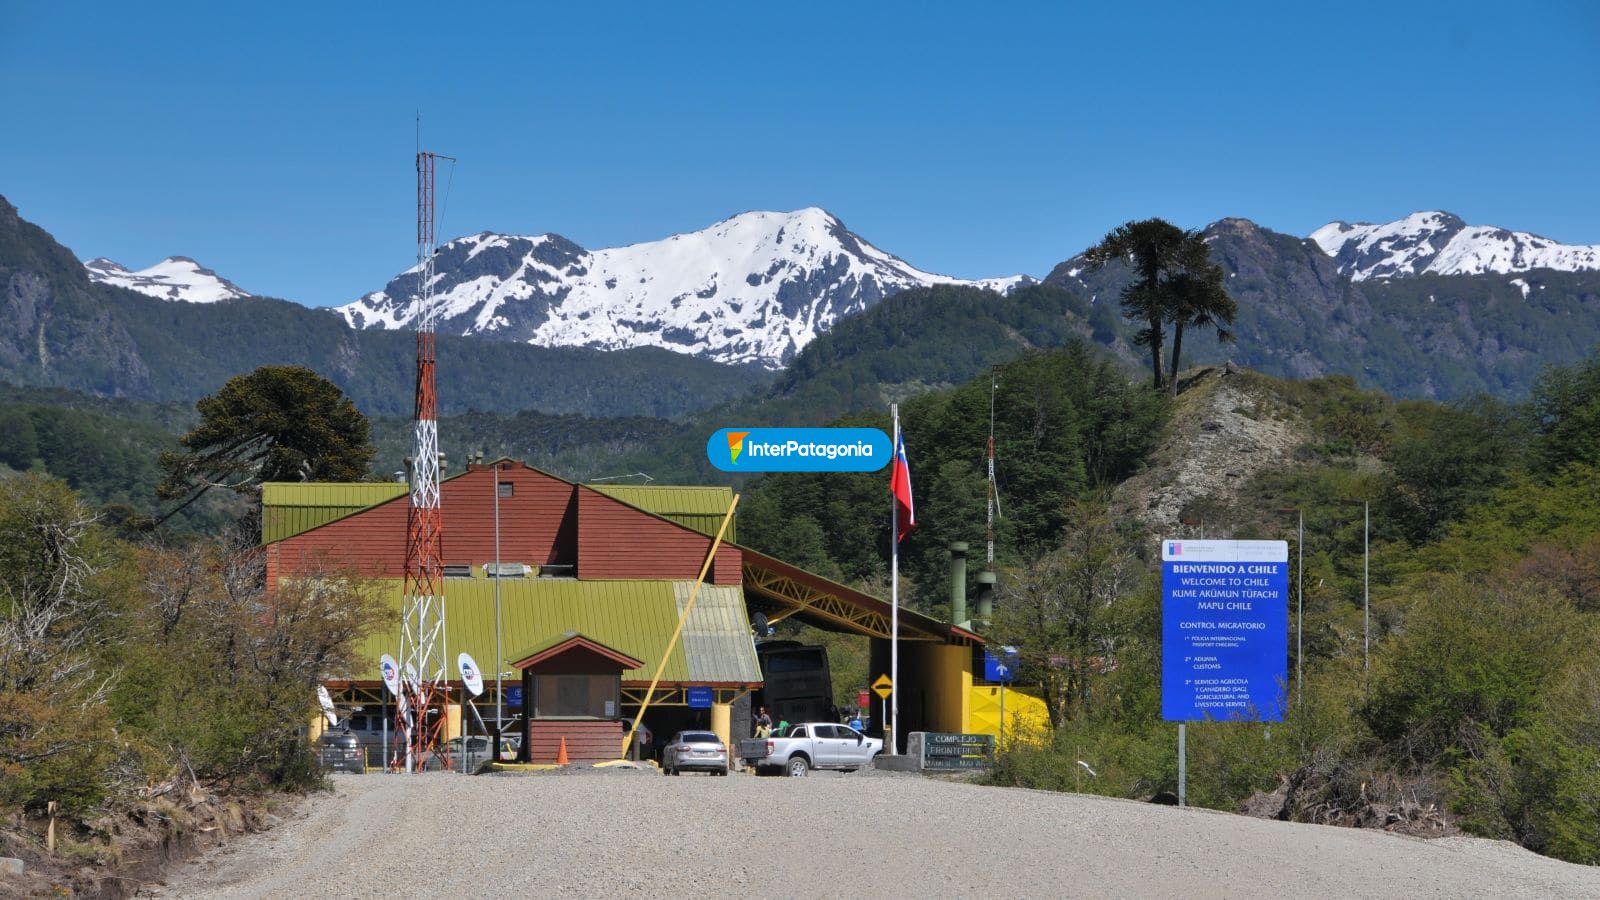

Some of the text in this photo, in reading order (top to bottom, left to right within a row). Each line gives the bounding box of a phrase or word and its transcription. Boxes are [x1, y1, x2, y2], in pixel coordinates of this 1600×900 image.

[1173, 565, 1278, 575] BIENVENIDO A CHILE
[1181, 578, 1269, 587] WELCOME TO CHILE
[1197, 602, 1252, 610] MAPU CHILE
[1218, 622, 1266, 630] MIGRATORIO
[935, 735, 977, 743] COMPLEJO
